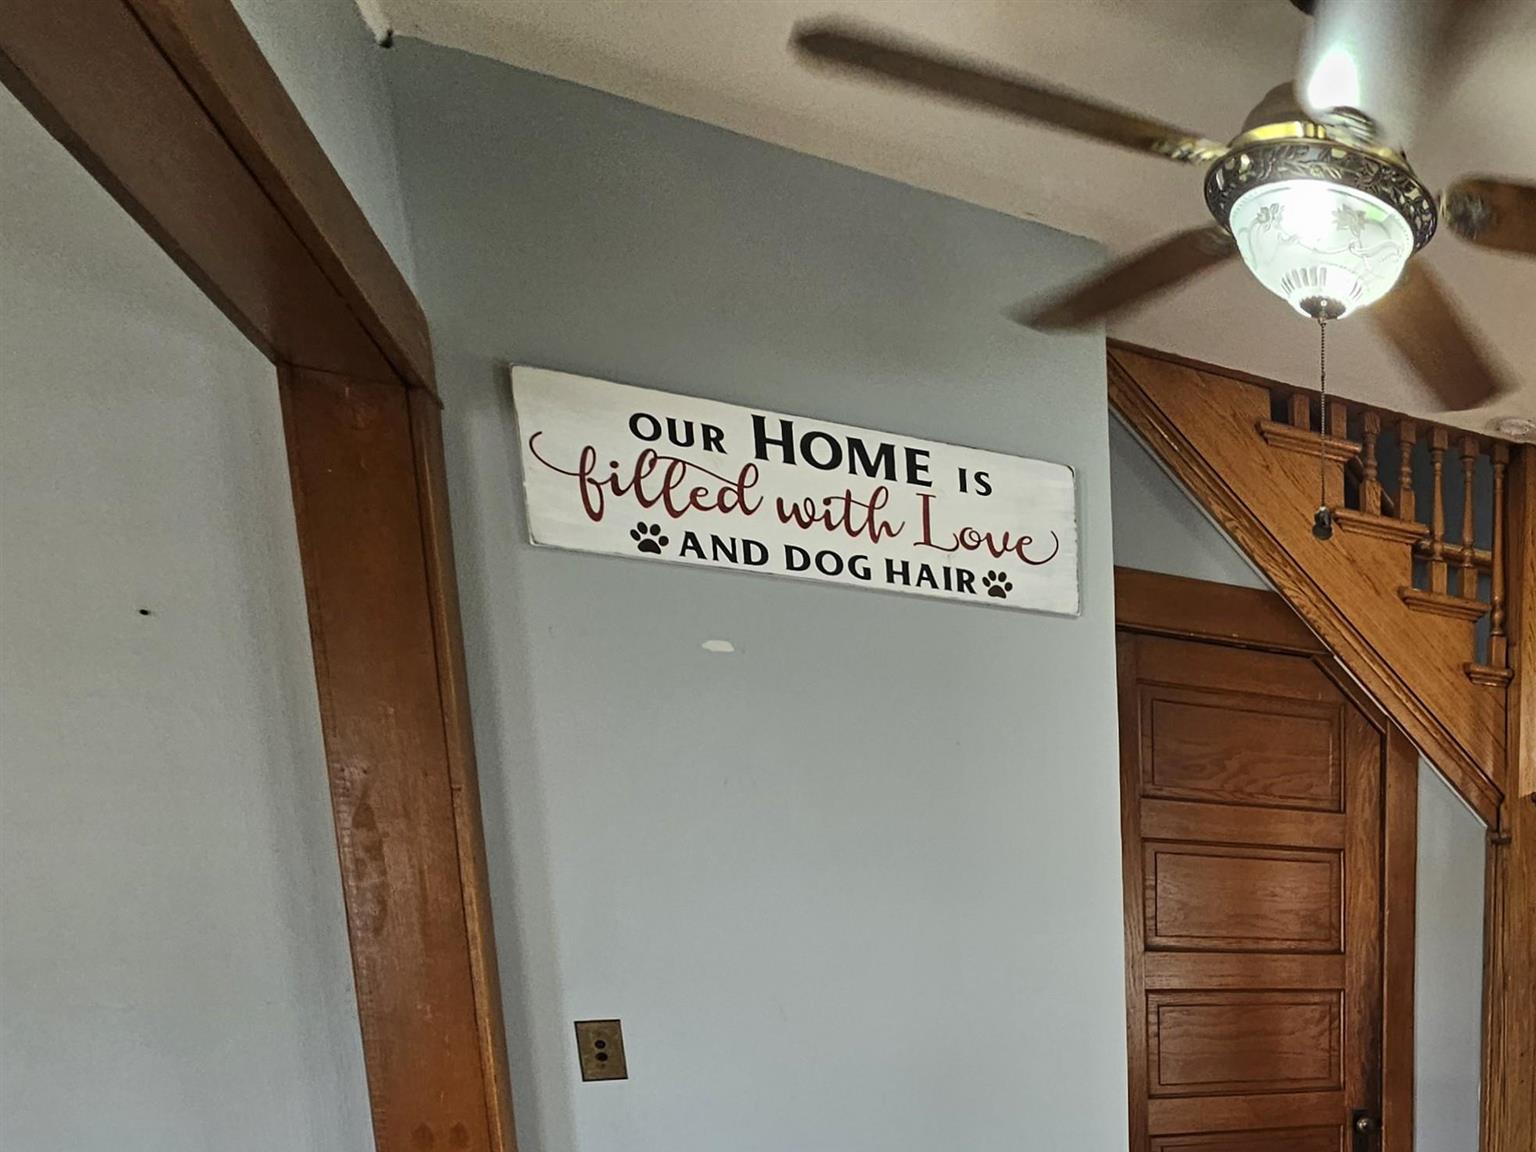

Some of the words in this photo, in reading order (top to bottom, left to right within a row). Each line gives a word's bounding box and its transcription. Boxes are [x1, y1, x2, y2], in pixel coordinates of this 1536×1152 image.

[628, 412, 728, 455] OUR
[751, 413, 933, 488] HOME
[958, 467, 993, 497] IS
[529, 431, 764, 522] filled
[776, 485, 905, 544] with
[913, 493, 1059, 566] Love
[679, 530, 769, 566] AND
[784, 544, 872, 581] DOG
[885, 557, 977, 594] HAIR
